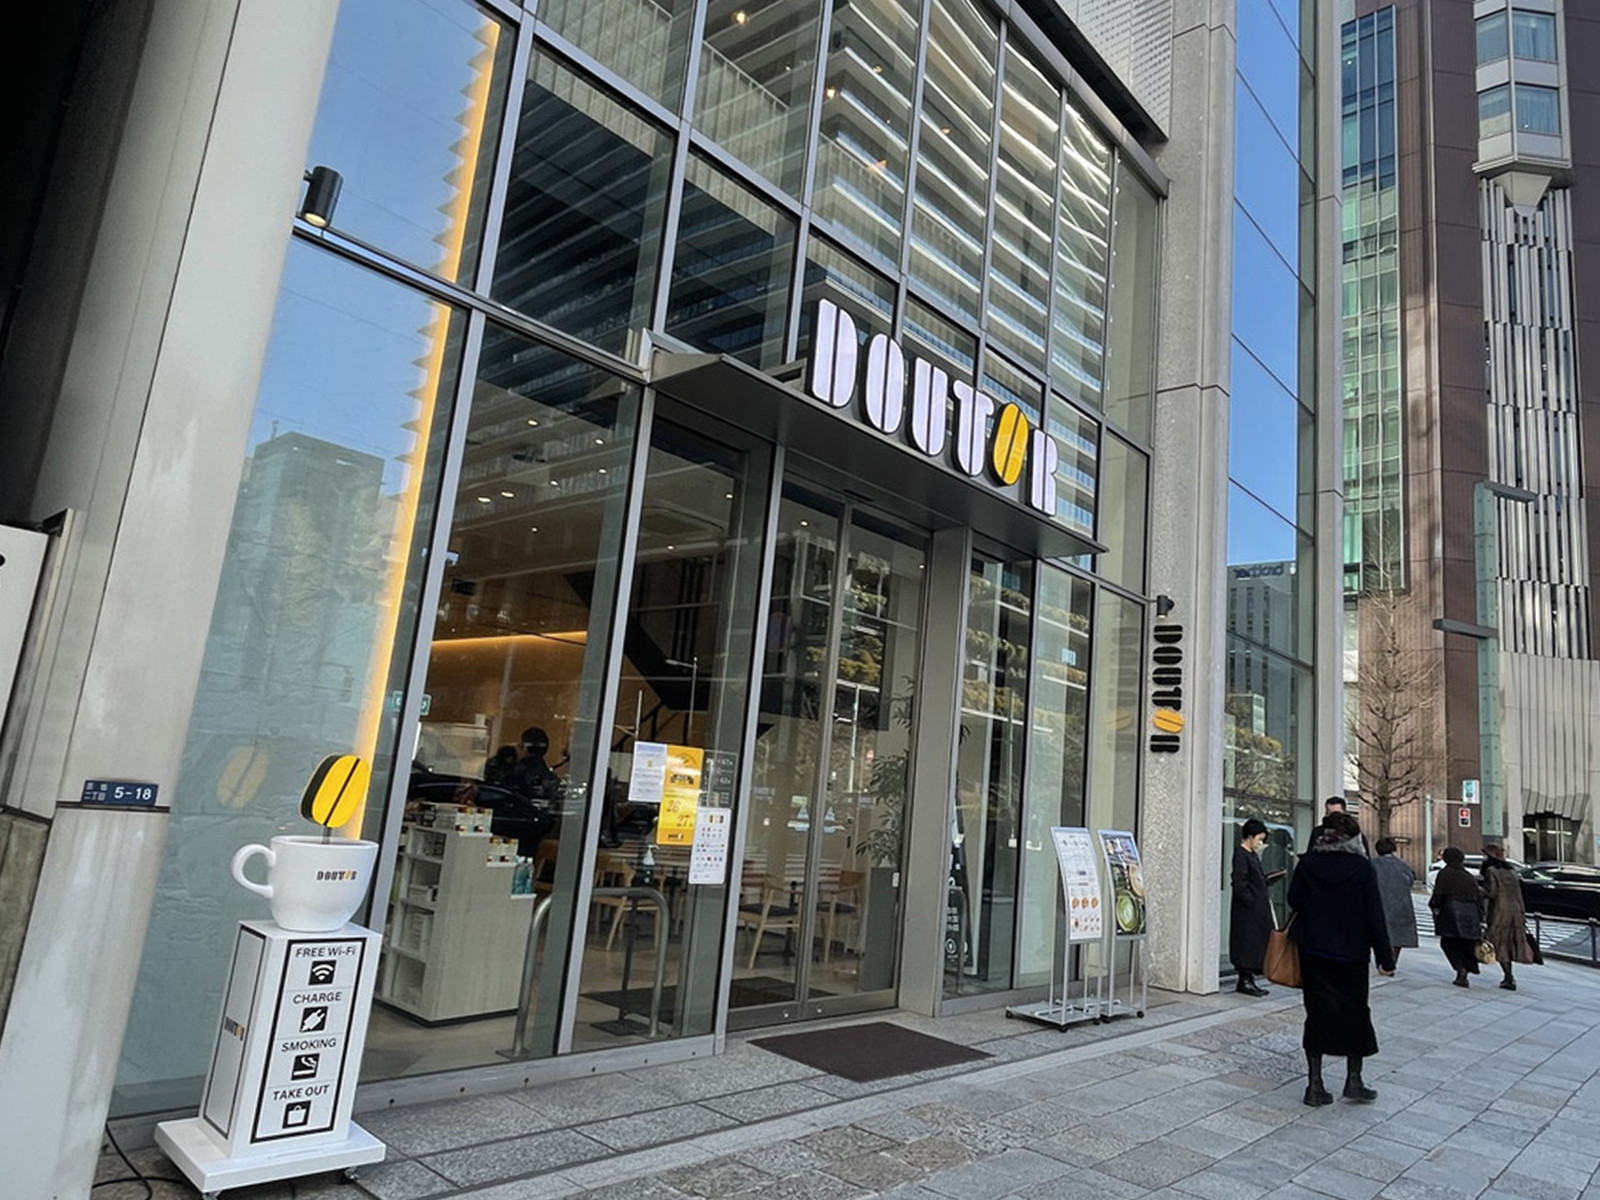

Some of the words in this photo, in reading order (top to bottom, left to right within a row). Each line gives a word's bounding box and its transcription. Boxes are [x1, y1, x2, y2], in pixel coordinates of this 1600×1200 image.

[809, 298, 1059, 517] DOUTOR
[1149, 624, 1186, 754] DOUTOR
[114, 786, 152, 800] 5-18
[295, 947, 326, 958] FREE
[327, 946, 357, 957] Wi-Fi
[292, 991, 343, 1005] CHARGE
[281, 1037, 337, 1053] SMOKING
[272, 1088, 303, 1101] TAKE
[304, 1084, 331, 1097] OUT
